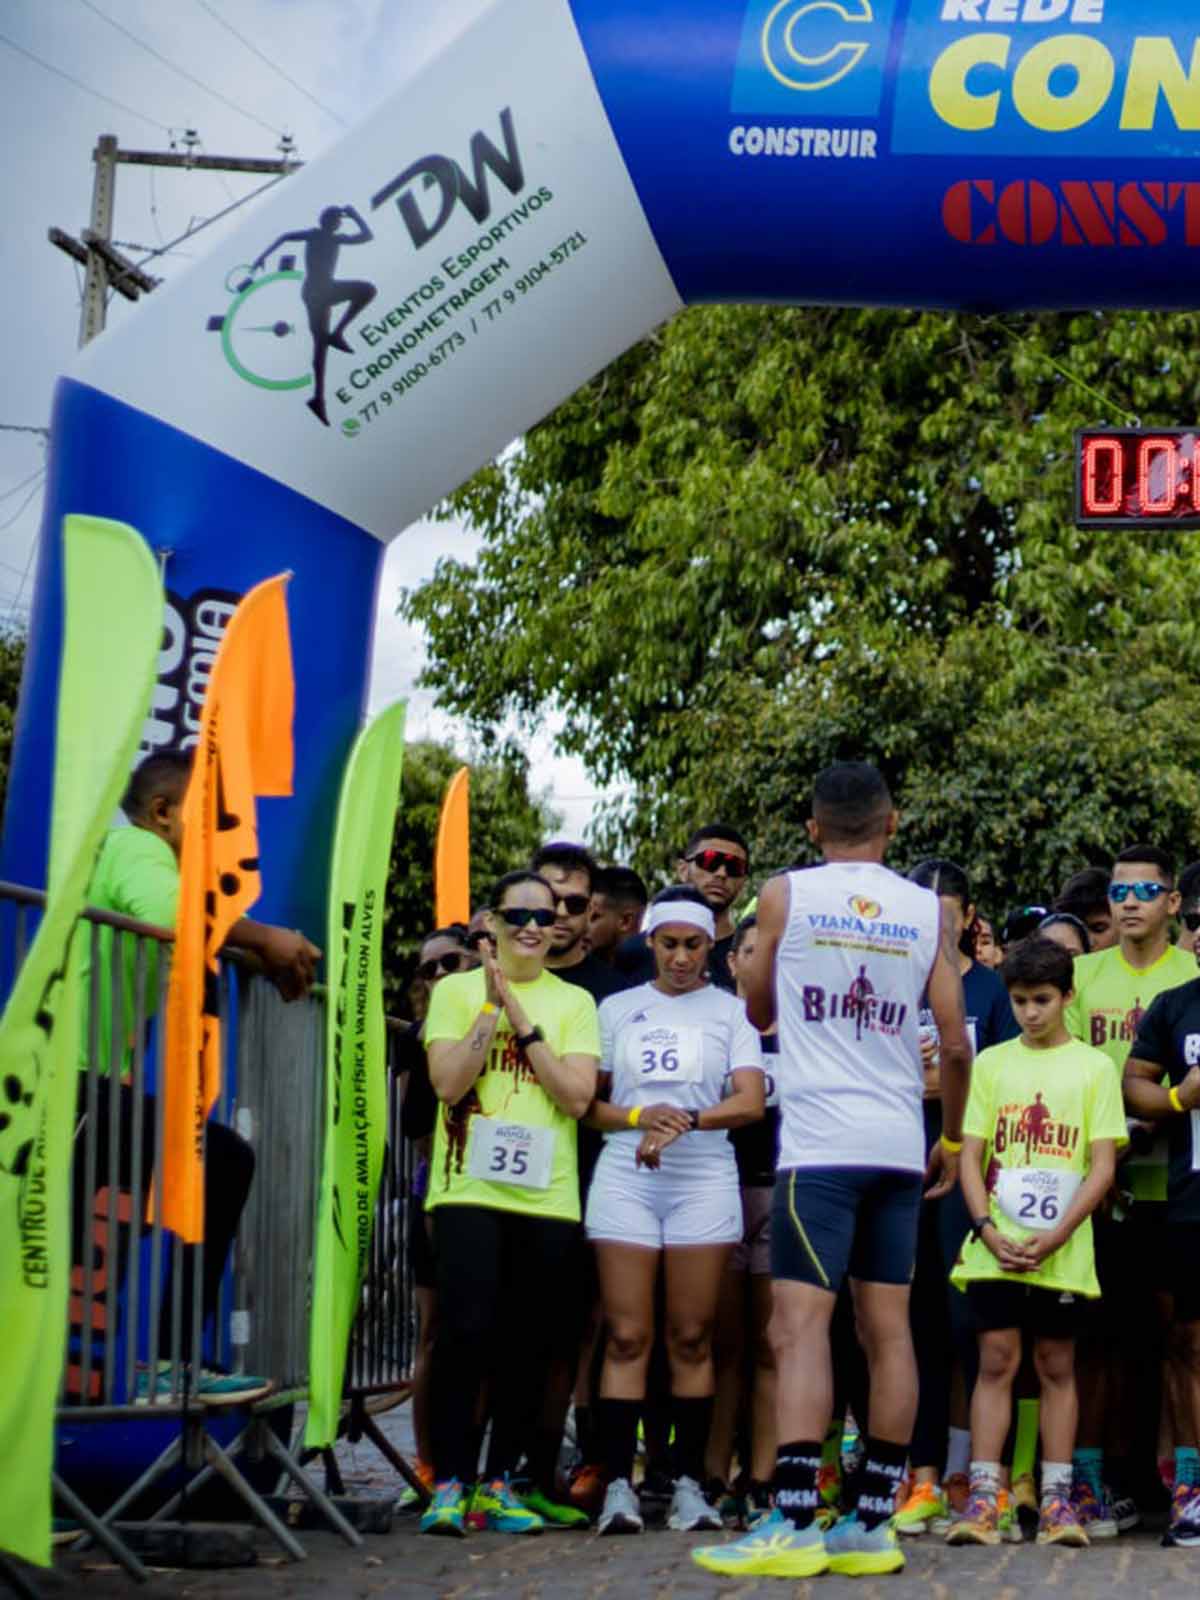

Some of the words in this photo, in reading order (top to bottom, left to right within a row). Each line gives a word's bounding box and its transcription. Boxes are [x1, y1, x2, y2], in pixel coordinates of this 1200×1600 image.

[729, 126, 877, 158] CONSTRUIR
[371, 106, 525, 250] DW
[360, 276, 446, 347] EVENTOS
[441, 186, 553, 282] ESPORTIVOS
[349, 257, 511, 390] CRONOMETRAGEM
[359, 401, 380, 422] 77
[380, 391, 393, 406] 9
[392, 330, 466, 397] 9100-6773
[482, 298, 503, 322] 77
[504, 289, 516, 304] 9
[515, 231, 588, 295] 9104-5721
[363, 888, 376, 940] ALVES
[808, 914, 866, 934] VIANA
[355, 945, 371, 1036] VANDILSON
[352, 1041, 368, 1094] FÍSICA
[641, 1049, 679, 1073] 36
[353, 1096, 371, 1180] AVALIAÇÃO
[489, 1146, 528, 1175] 35
[357, 1181, 369, 1205] DE
[1018, 1192, 1059, 1221] 26
[21, 1199, 48, 1289] CENTRO
